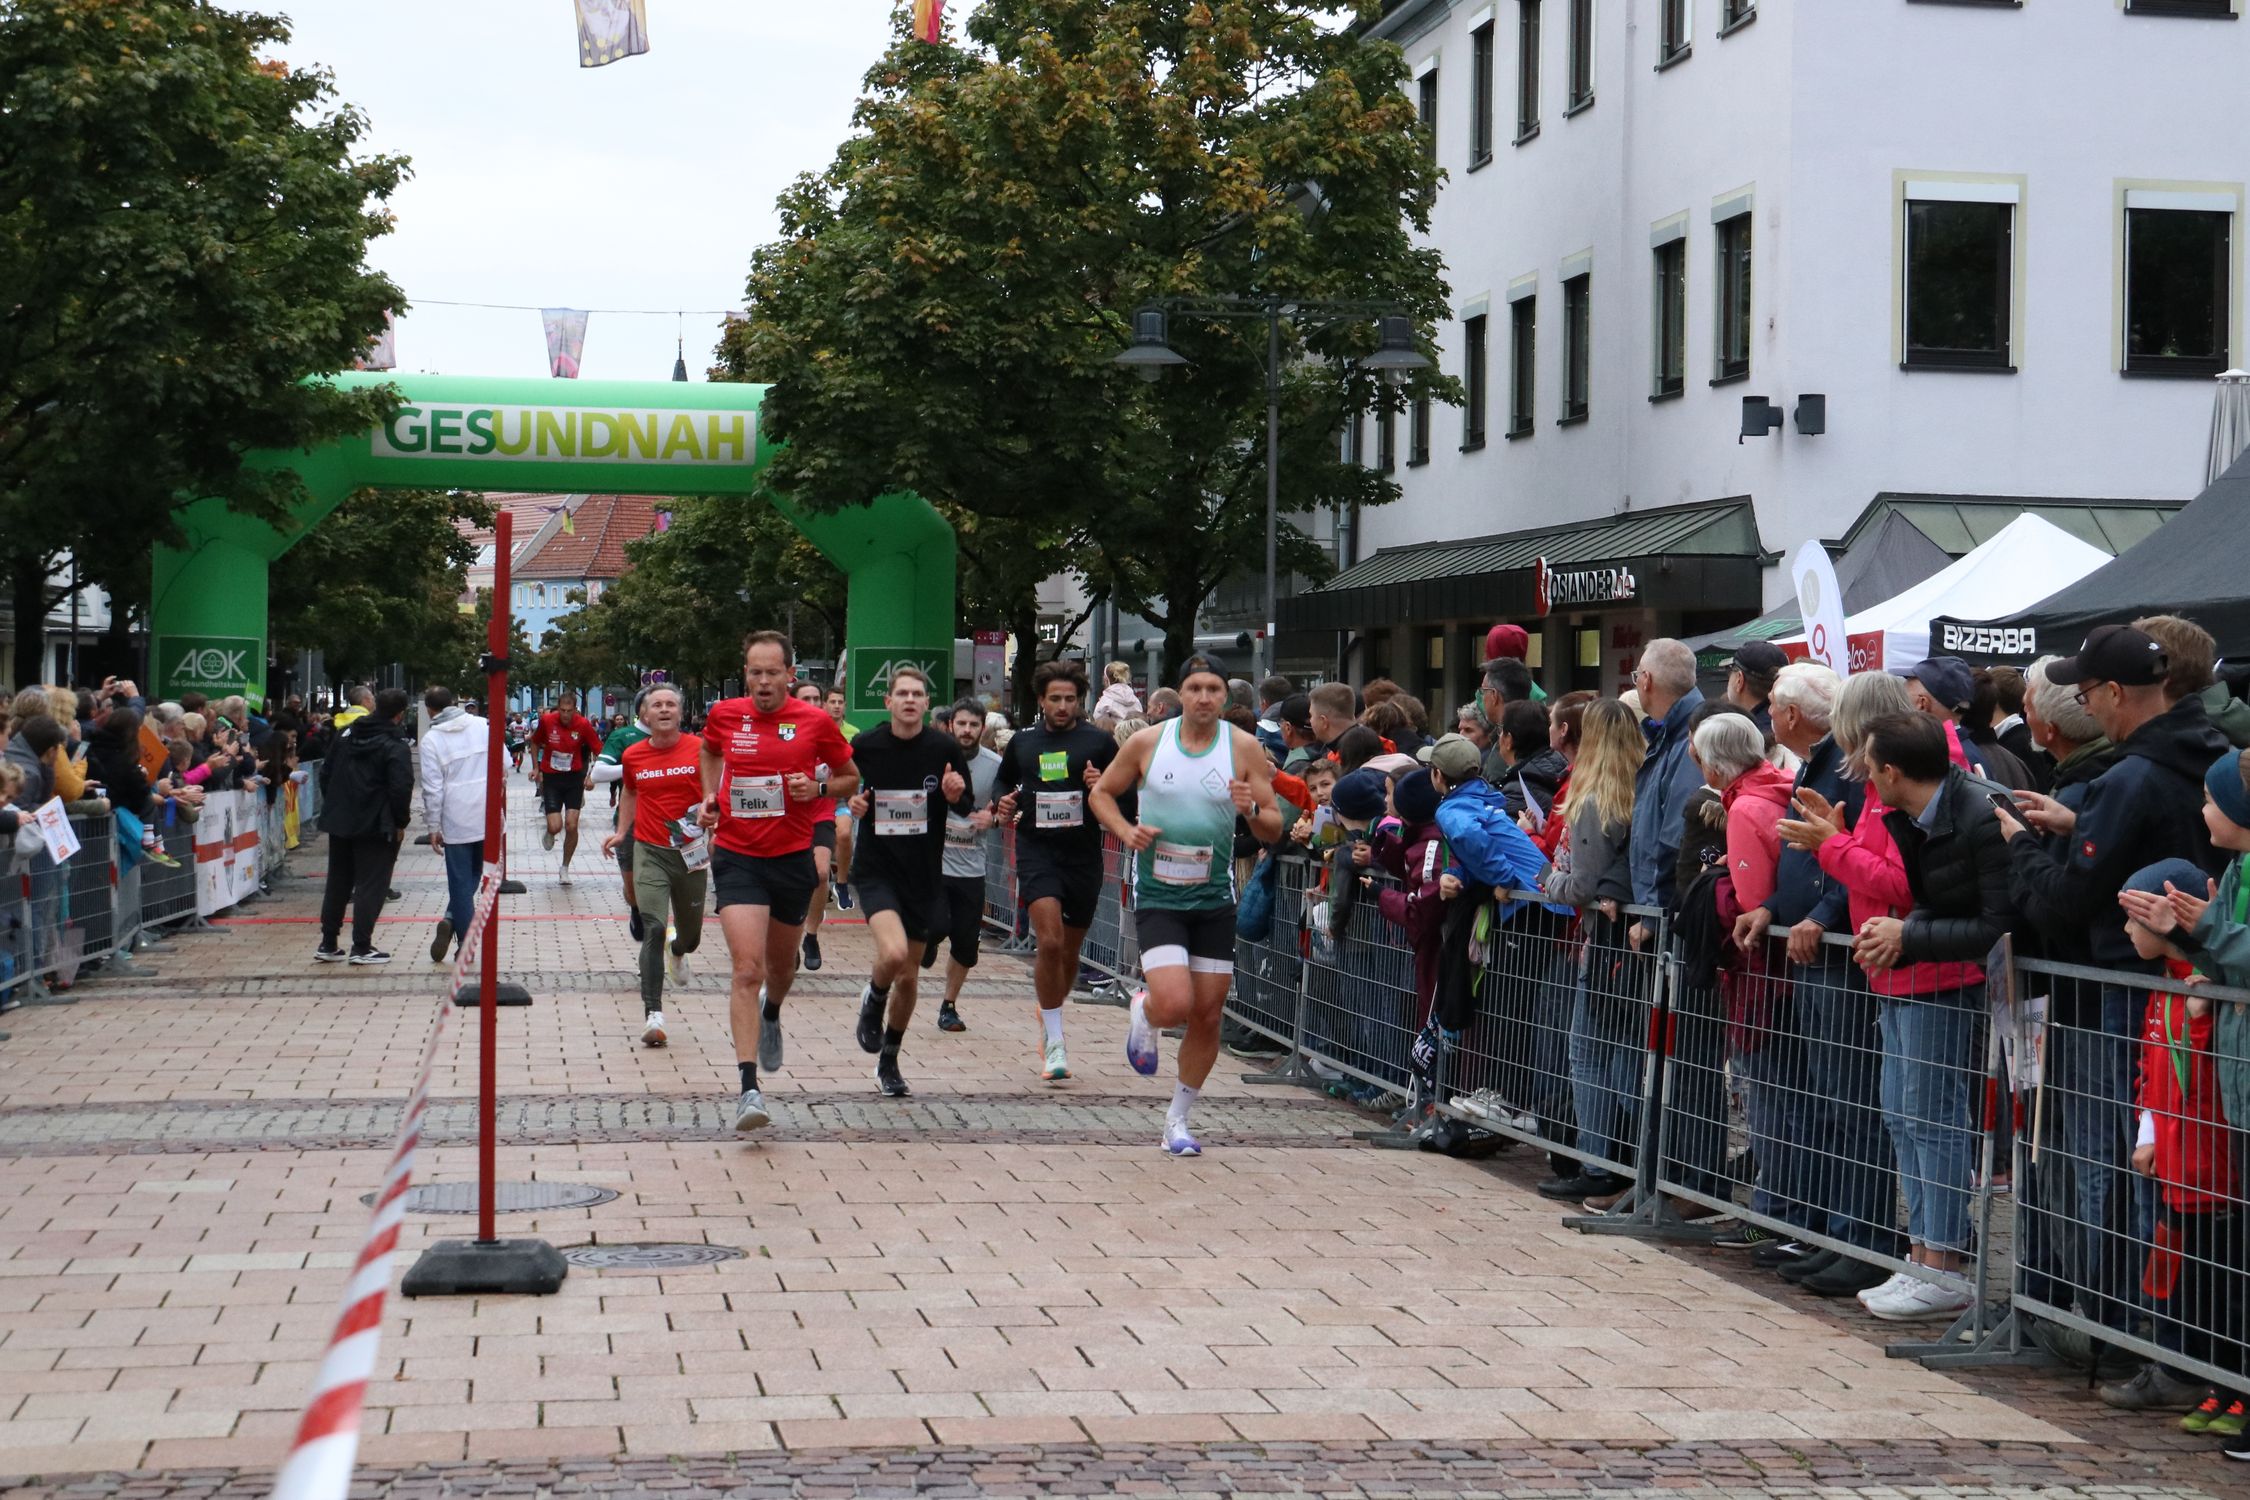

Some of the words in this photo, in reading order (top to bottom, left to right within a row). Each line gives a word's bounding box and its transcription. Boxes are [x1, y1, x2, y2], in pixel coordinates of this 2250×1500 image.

[384, 407, 745, 461] GESUNDNAH
[1943, 624, 2036, 654] BIZERBA
[171, 648, 247, 680] AOK
[635, 768, 665, 781] MÖBEL
[666, 765, 696, 777] ROGG
[740, 798, 768, 809] Felix
[888, 808, 912, 820] Tom
[1047, 810, 1071, 821] Luca
